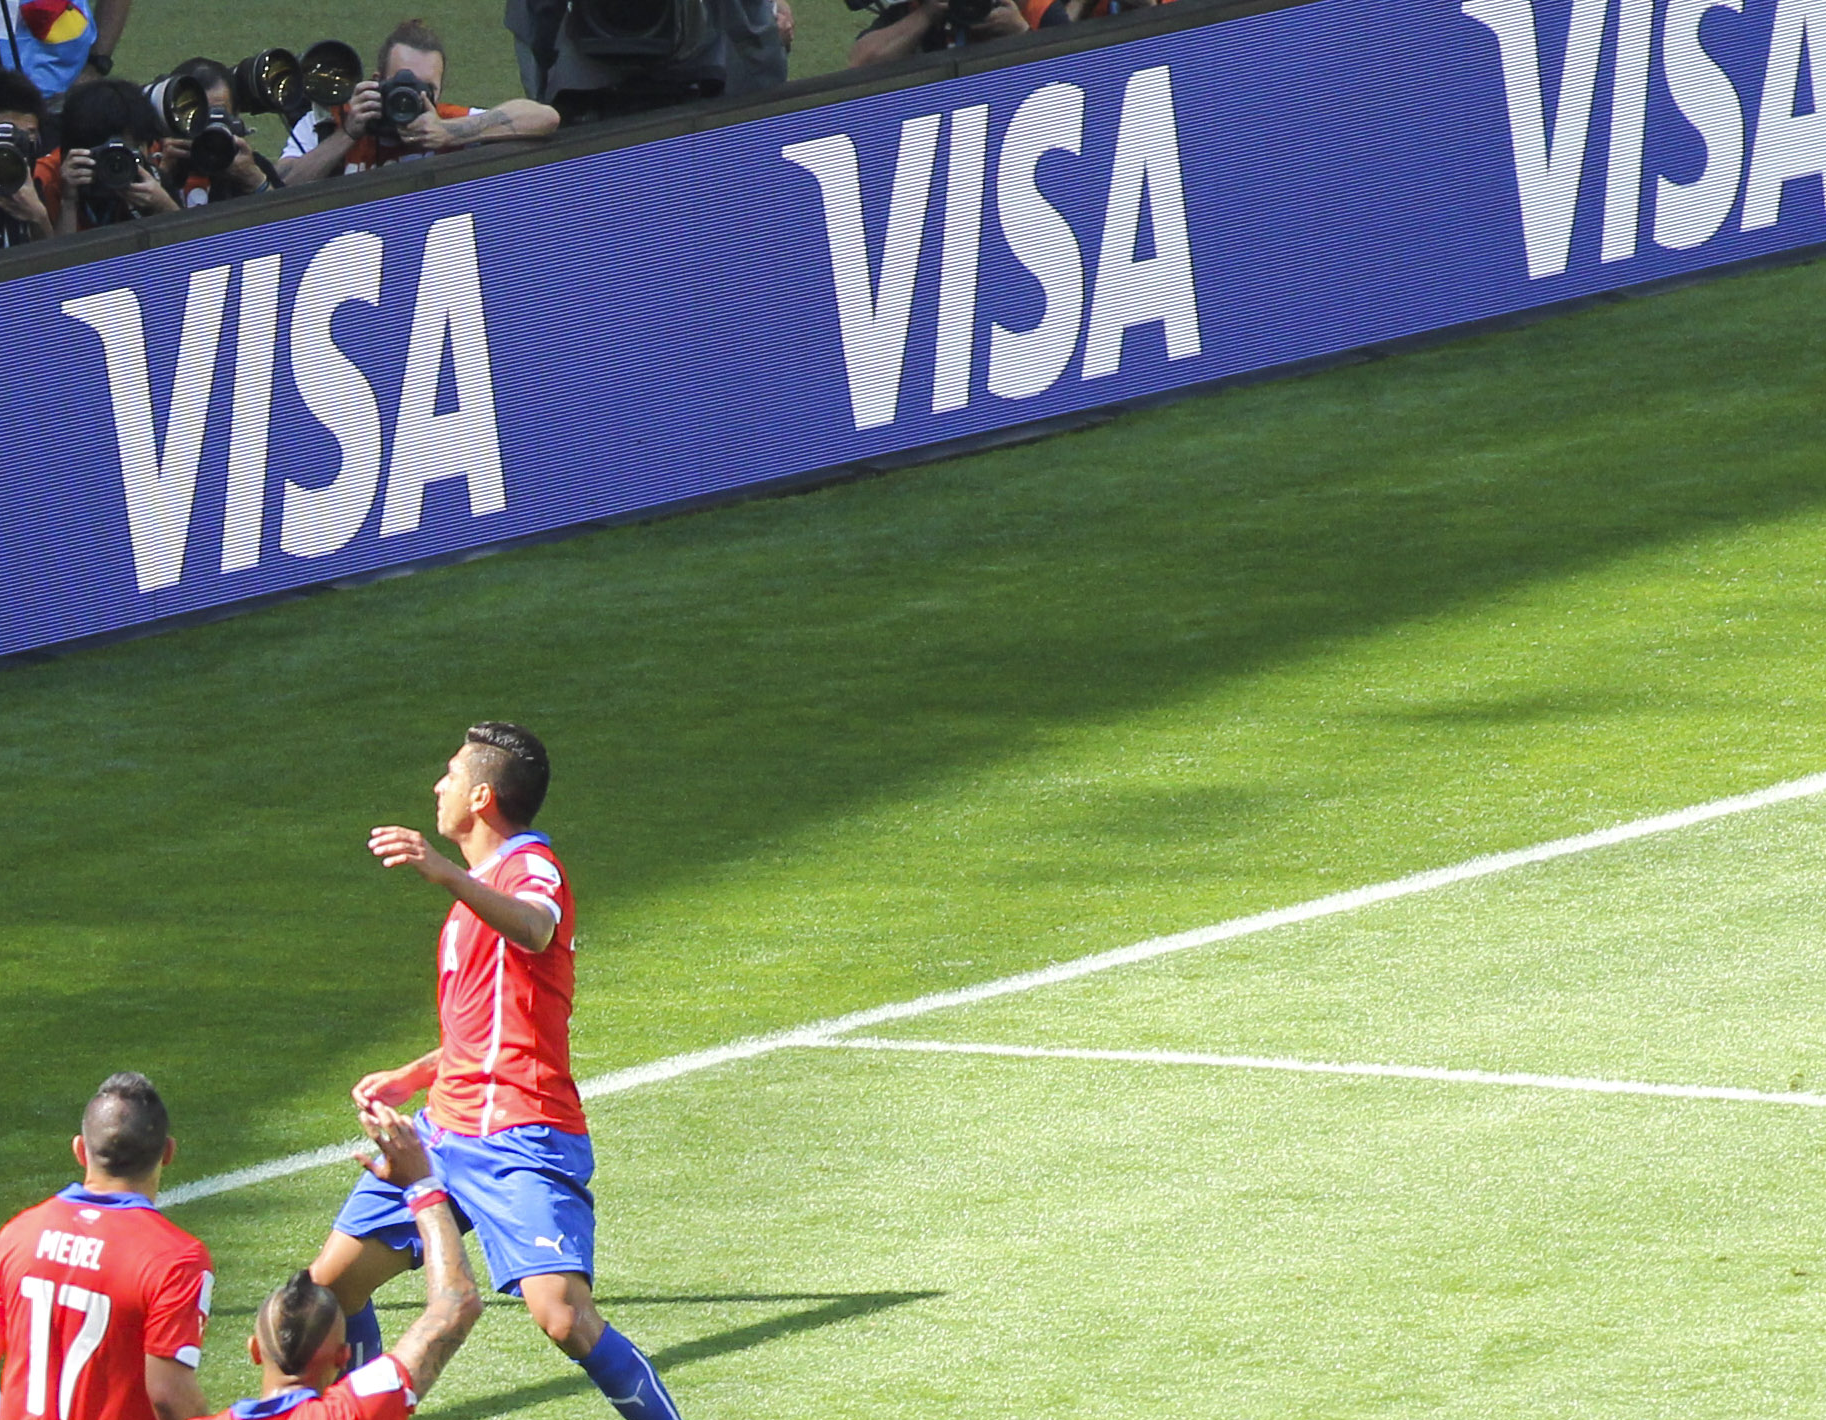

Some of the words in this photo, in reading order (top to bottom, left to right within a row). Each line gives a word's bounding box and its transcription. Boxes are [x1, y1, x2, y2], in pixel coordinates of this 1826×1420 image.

[61, 213, 507, 594] VISA
[780, 65, 1203, 431] VISA
[36, 1229, 104, 1271] MEDEL
